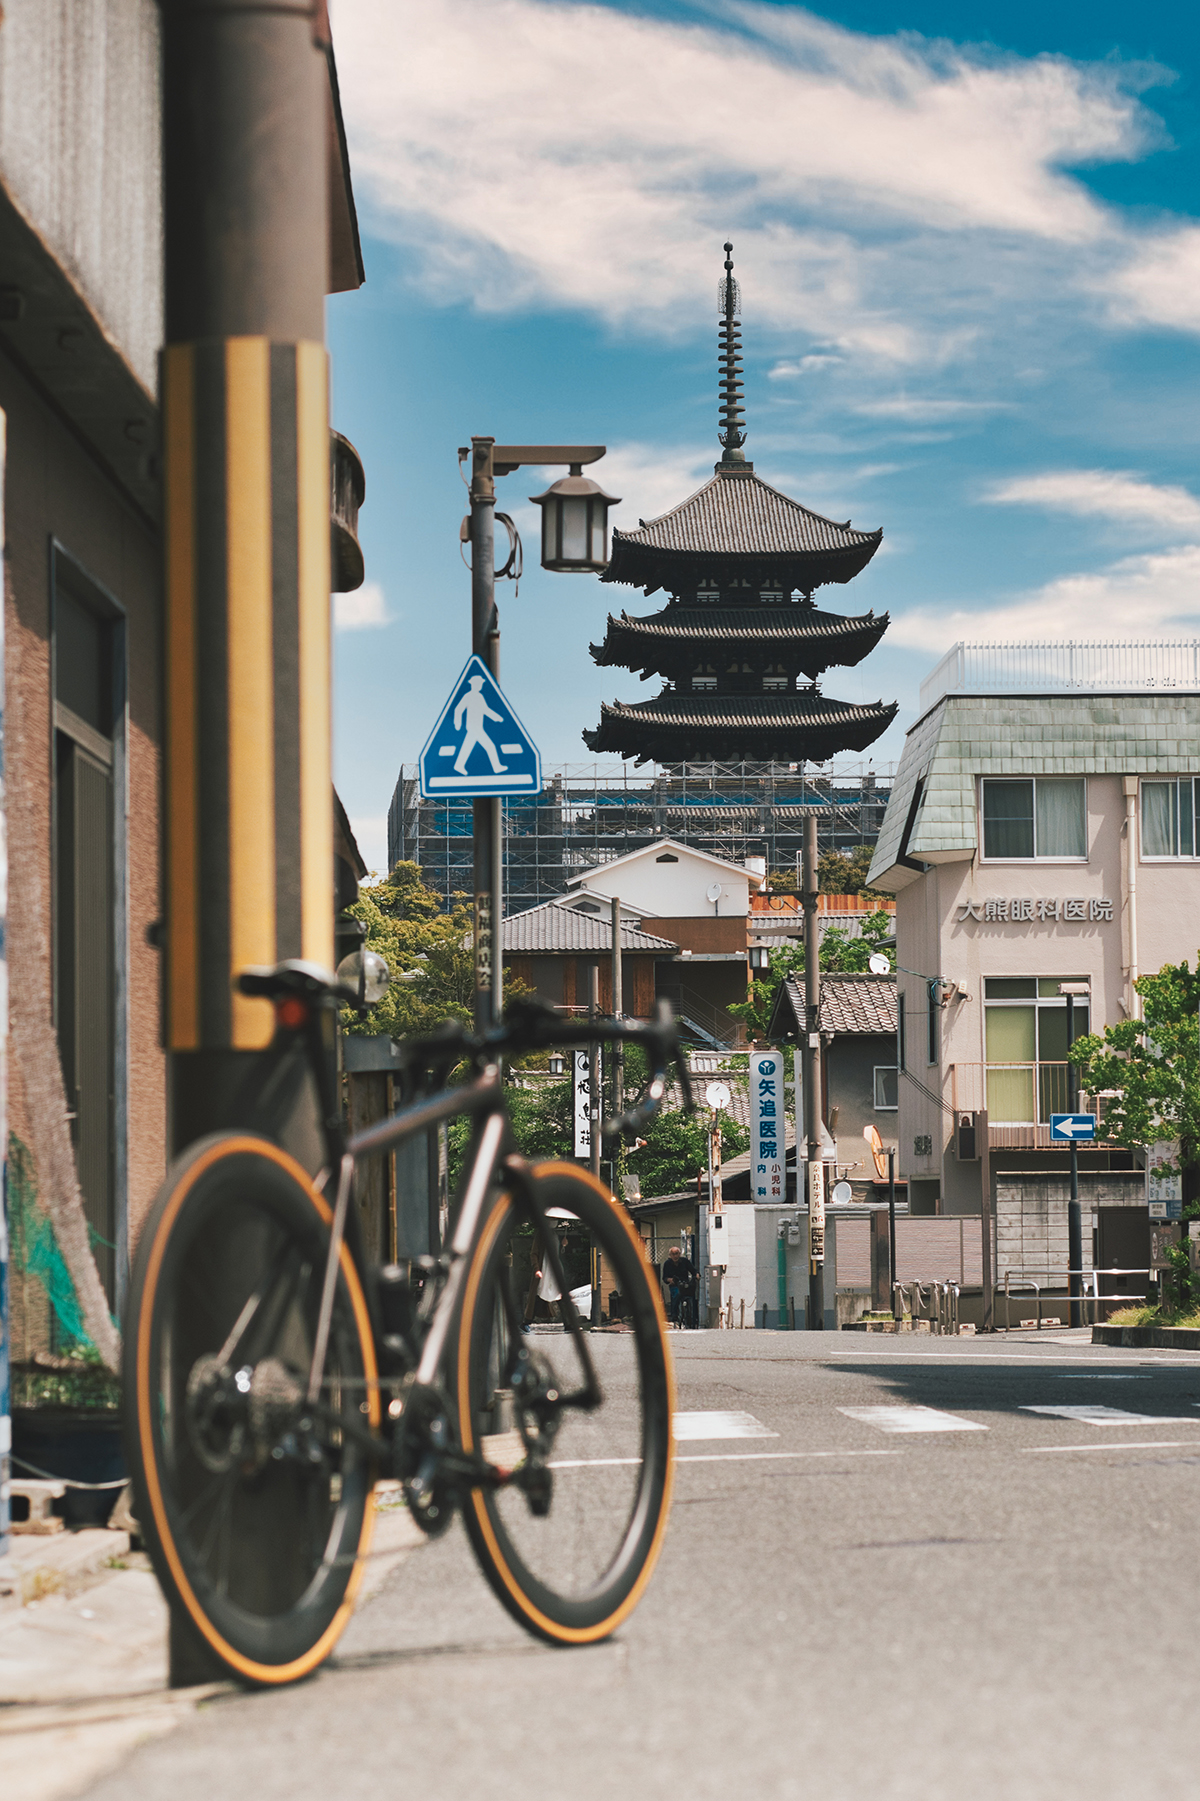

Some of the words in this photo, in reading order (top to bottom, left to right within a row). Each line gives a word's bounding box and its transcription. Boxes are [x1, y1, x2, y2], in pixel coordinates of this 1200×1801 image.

[958, 897, 1114, 922] 大熊眼科医院
[758, 1078, 778, 1159] 矢追医院
[757, 1163, 767, 1196] 内科
[771, 1163, 781, 1196] 小児科
[812, 1164, 821, 1209] 奈良ホテル
